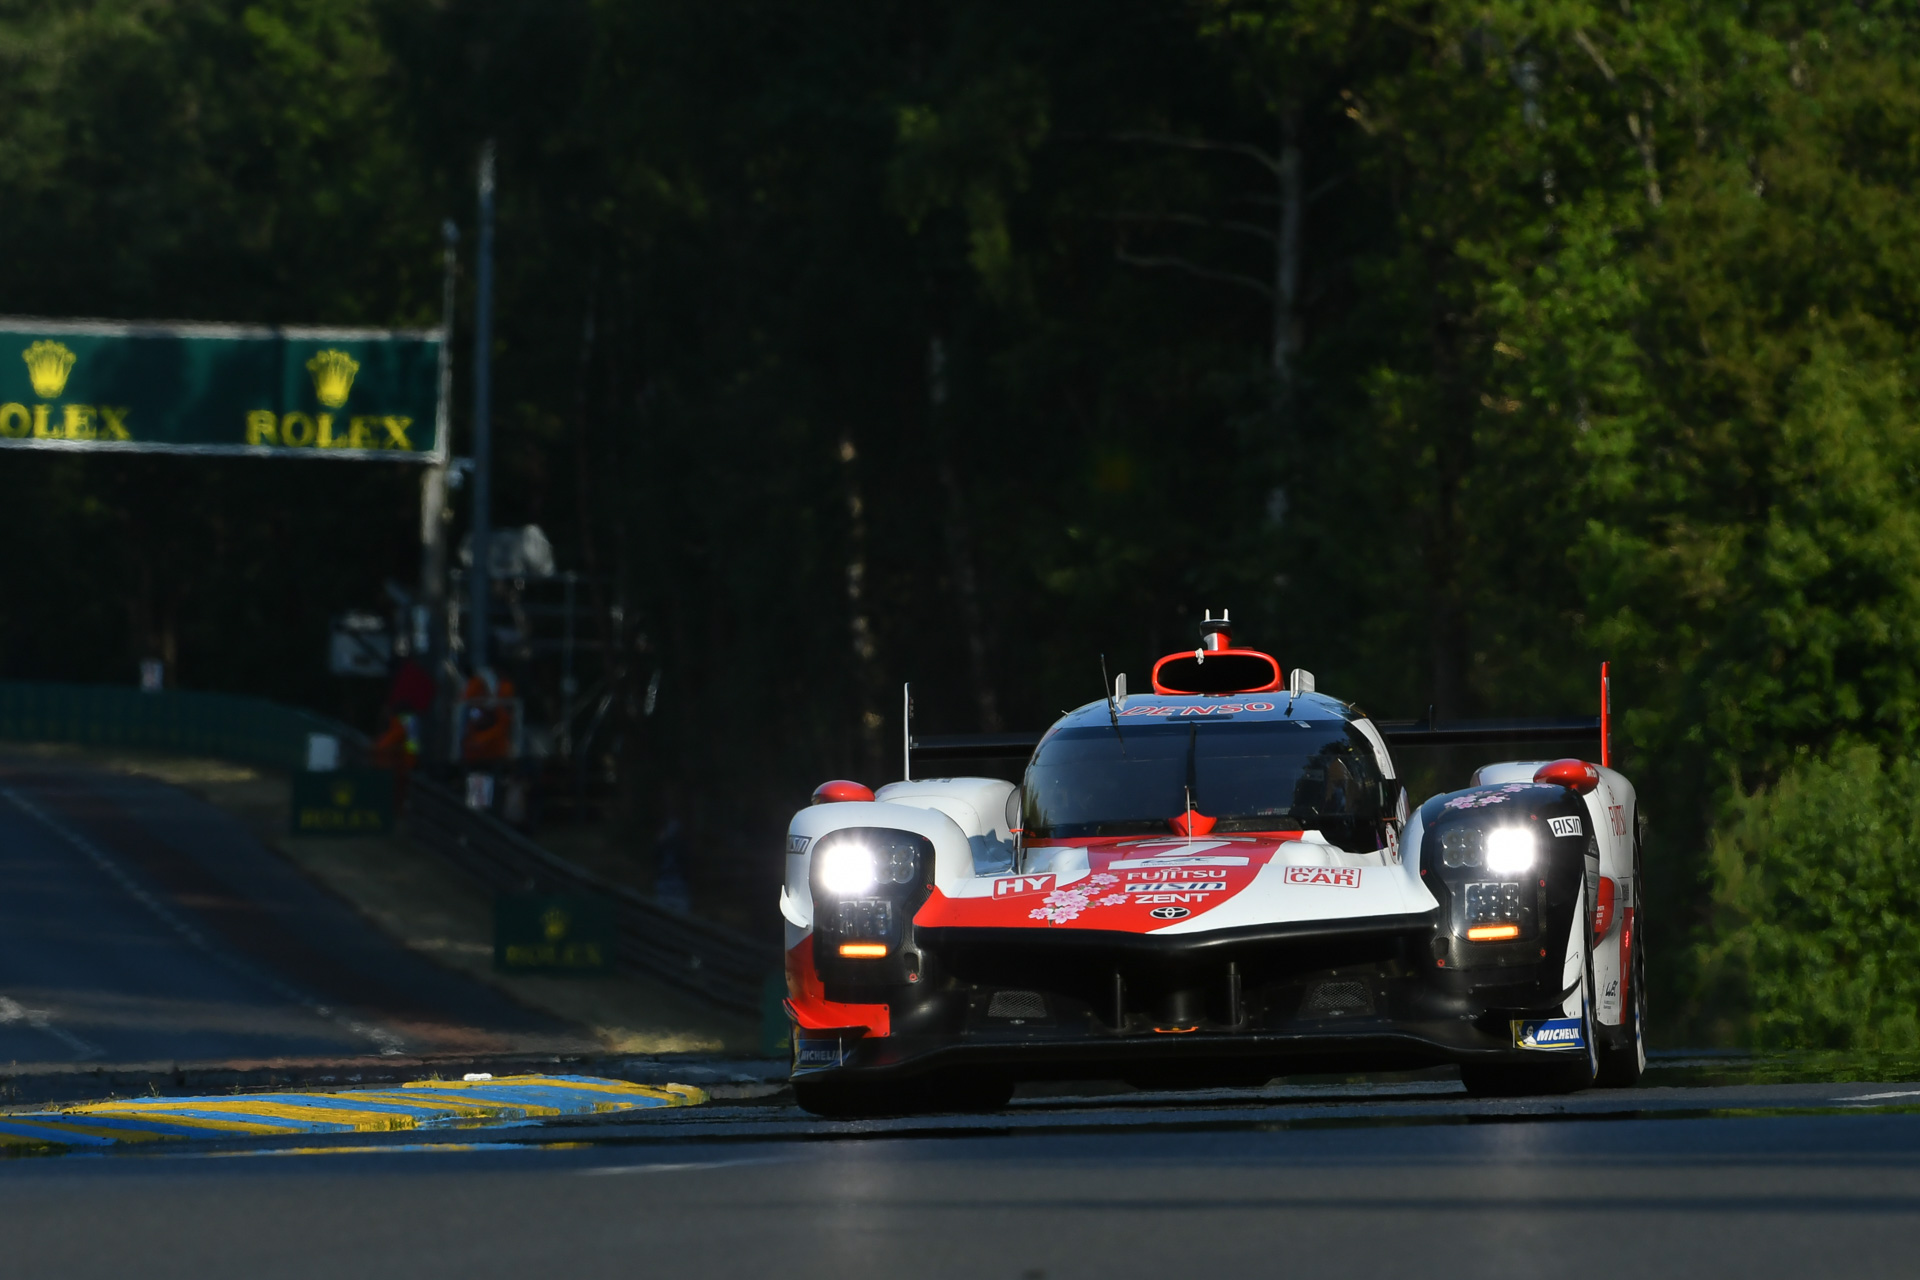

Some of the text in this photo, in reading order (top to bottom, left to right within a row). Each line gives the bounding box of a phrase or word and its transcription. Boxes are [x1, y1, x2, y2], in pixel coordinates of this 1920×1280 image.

[246, 409, 412, 450] ROLEX
[1117, 702, 1274, 717] DENSO
[1553, 818, 1582, 834] AISIN
[1127, 867, 1226, 881] FUJITSU
[1291, 867, 1354, 875] HYPER
[999, 875, 1049, 895] HY
[1128, 882, 1223, 891] AISIN
[1290, 873, 1354, 886] CAR
[1135, 893, 1209, 903] ZENT
[1537, 1027, 1579, 1041] MICHELIN
